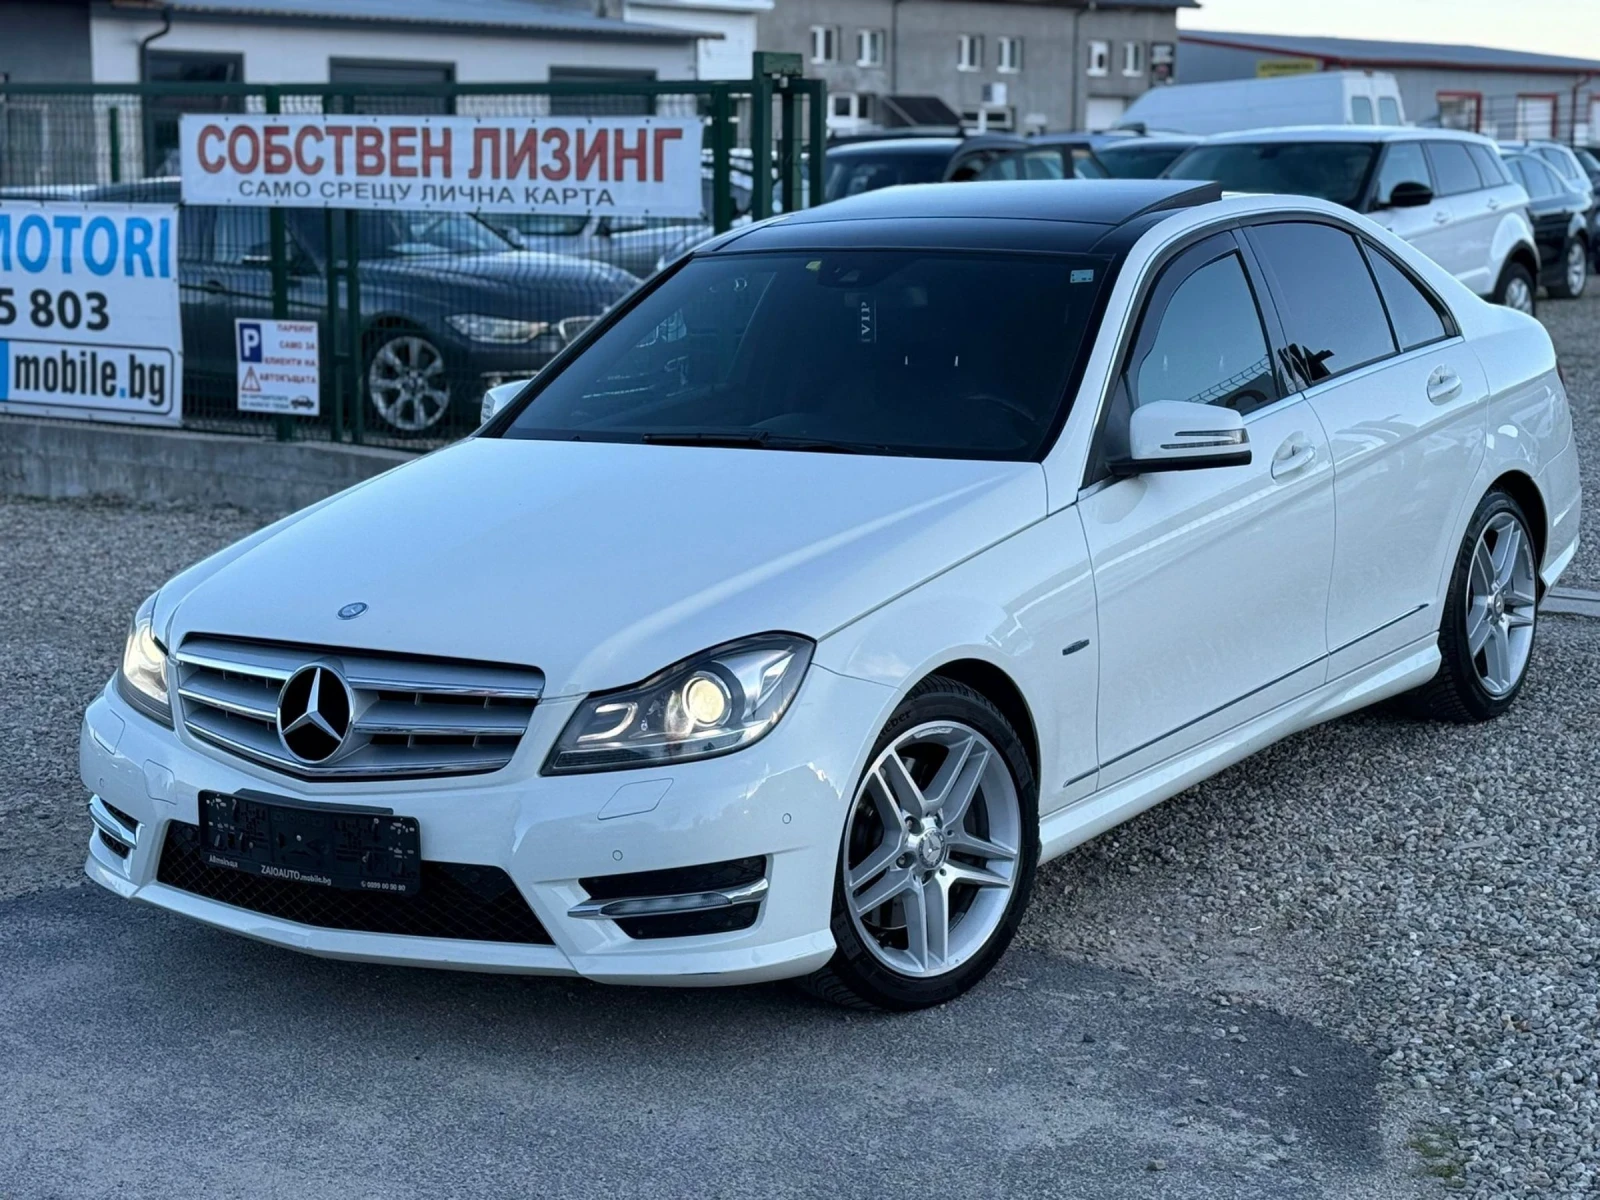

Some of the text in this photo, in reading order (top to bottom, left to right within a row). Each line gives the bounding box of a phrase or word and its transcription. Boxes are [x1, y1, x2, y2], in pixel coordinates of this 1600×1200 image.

[197, 124, 683, 182] СОБСТВЕН ЛИЗИНГ
[239, 180, 615, 206] САМО СРЕЩУ ЛИЧНА КАРТА
[29, 289, 110, 331] 803
[14, 349, 166, 406] mobile.bg
